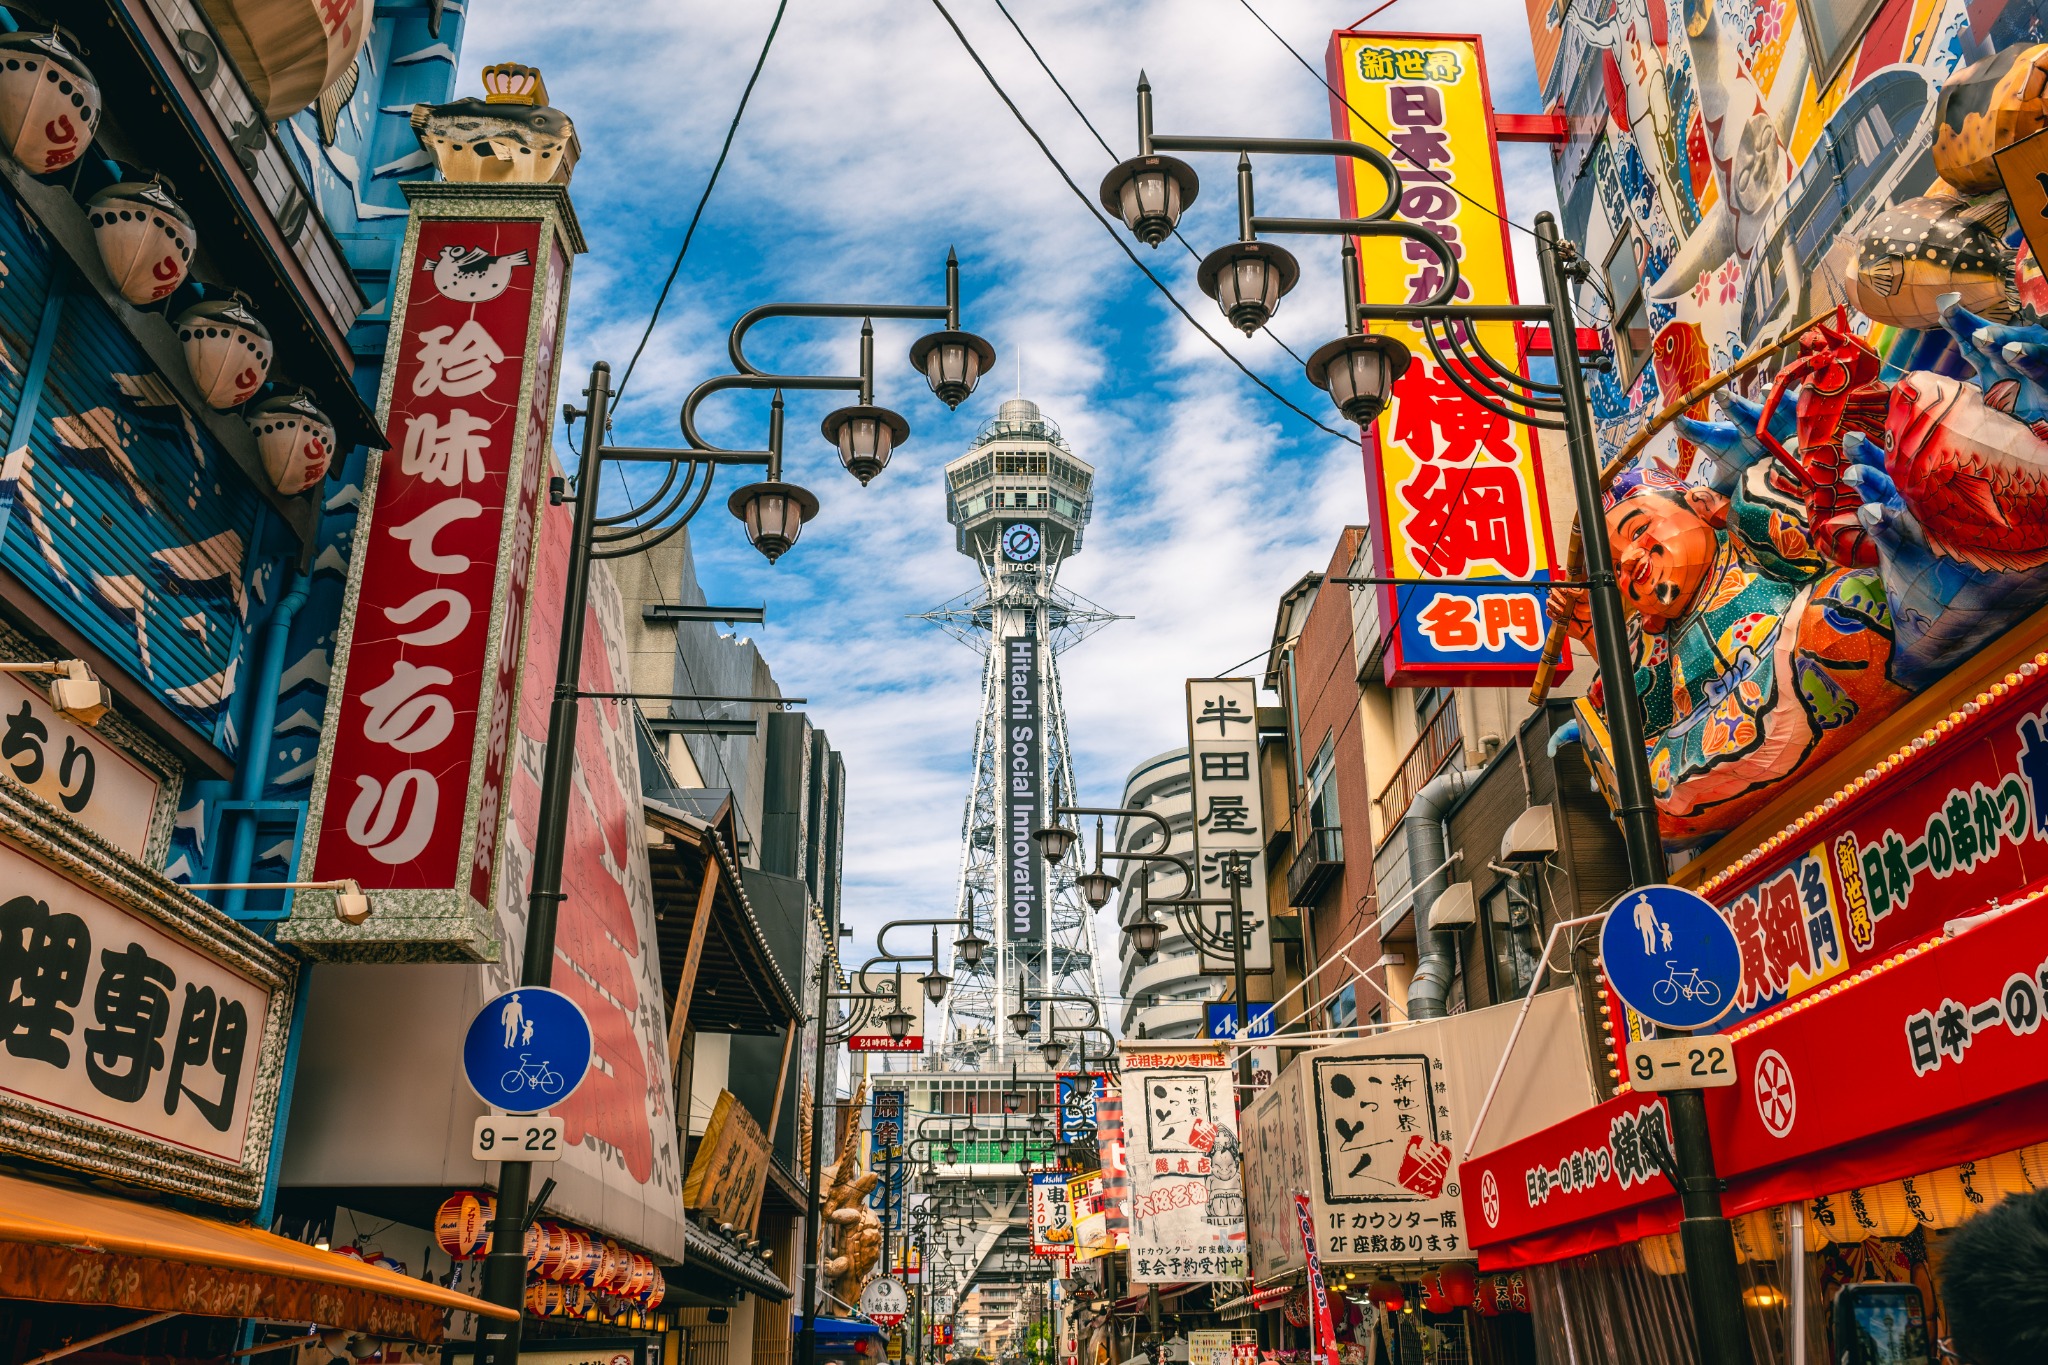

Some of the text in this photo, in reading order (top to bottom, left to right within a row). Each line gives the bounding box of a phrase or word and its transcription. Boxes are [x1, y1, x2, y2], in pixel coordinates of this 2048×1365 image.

[1361, 48, 1461, 82] 新世界
[1389, 85, 1470, 351] 日本一の串かつ
[1388, 355, 1530, 578] 横綱
[996, 563, 1046, 572] HITACHI
[1421, 597, 1541, 647] 名門
[0, 699, 97, 814] ちり
[1012, 641, 1036, 933] Hitachi Social Innovation
[1196, 695, 1264, 950] 半田屋酒店
[1862, 779, 2028, 917] 日本一の串かつ
[1800, 860, 1839, 970] 名門
[1838, 835, 1872, 946] 新世界
[0, 894, 248, 1133] 理専門
[1909, 970, 2048, 1071] 日本一の
[1126, 1053, 1226, 1068] 元祖串カツ専門店
[873, 1093, 900, 1146] 麻雀
[1391, 1074, 1420, 1133] 新世界
[1432, 1058, 1453, 1142] 商標登録
[1042, 1174, 1063, 1184] Asahi
[1155, 1157, 1212, 1173] 総本店
[1526, 1104, 1671, 1204] 日本一の串かつ 横綱
[441, 1221, 458, 1229] Asahi
[464, 1207, 476, 1244] アサヒビール
[1047, 1186, 1067, 1230] 串カツ
[1133, 1181, 1208, 1219] 大阪名物
[1329, 1210, 1458, 1229] 1F カウンター席
[1137, 1256, 1244, 1276] 宴会予約受付中
[1330, 1235, 1460, 1254] 2F 座敷あります
